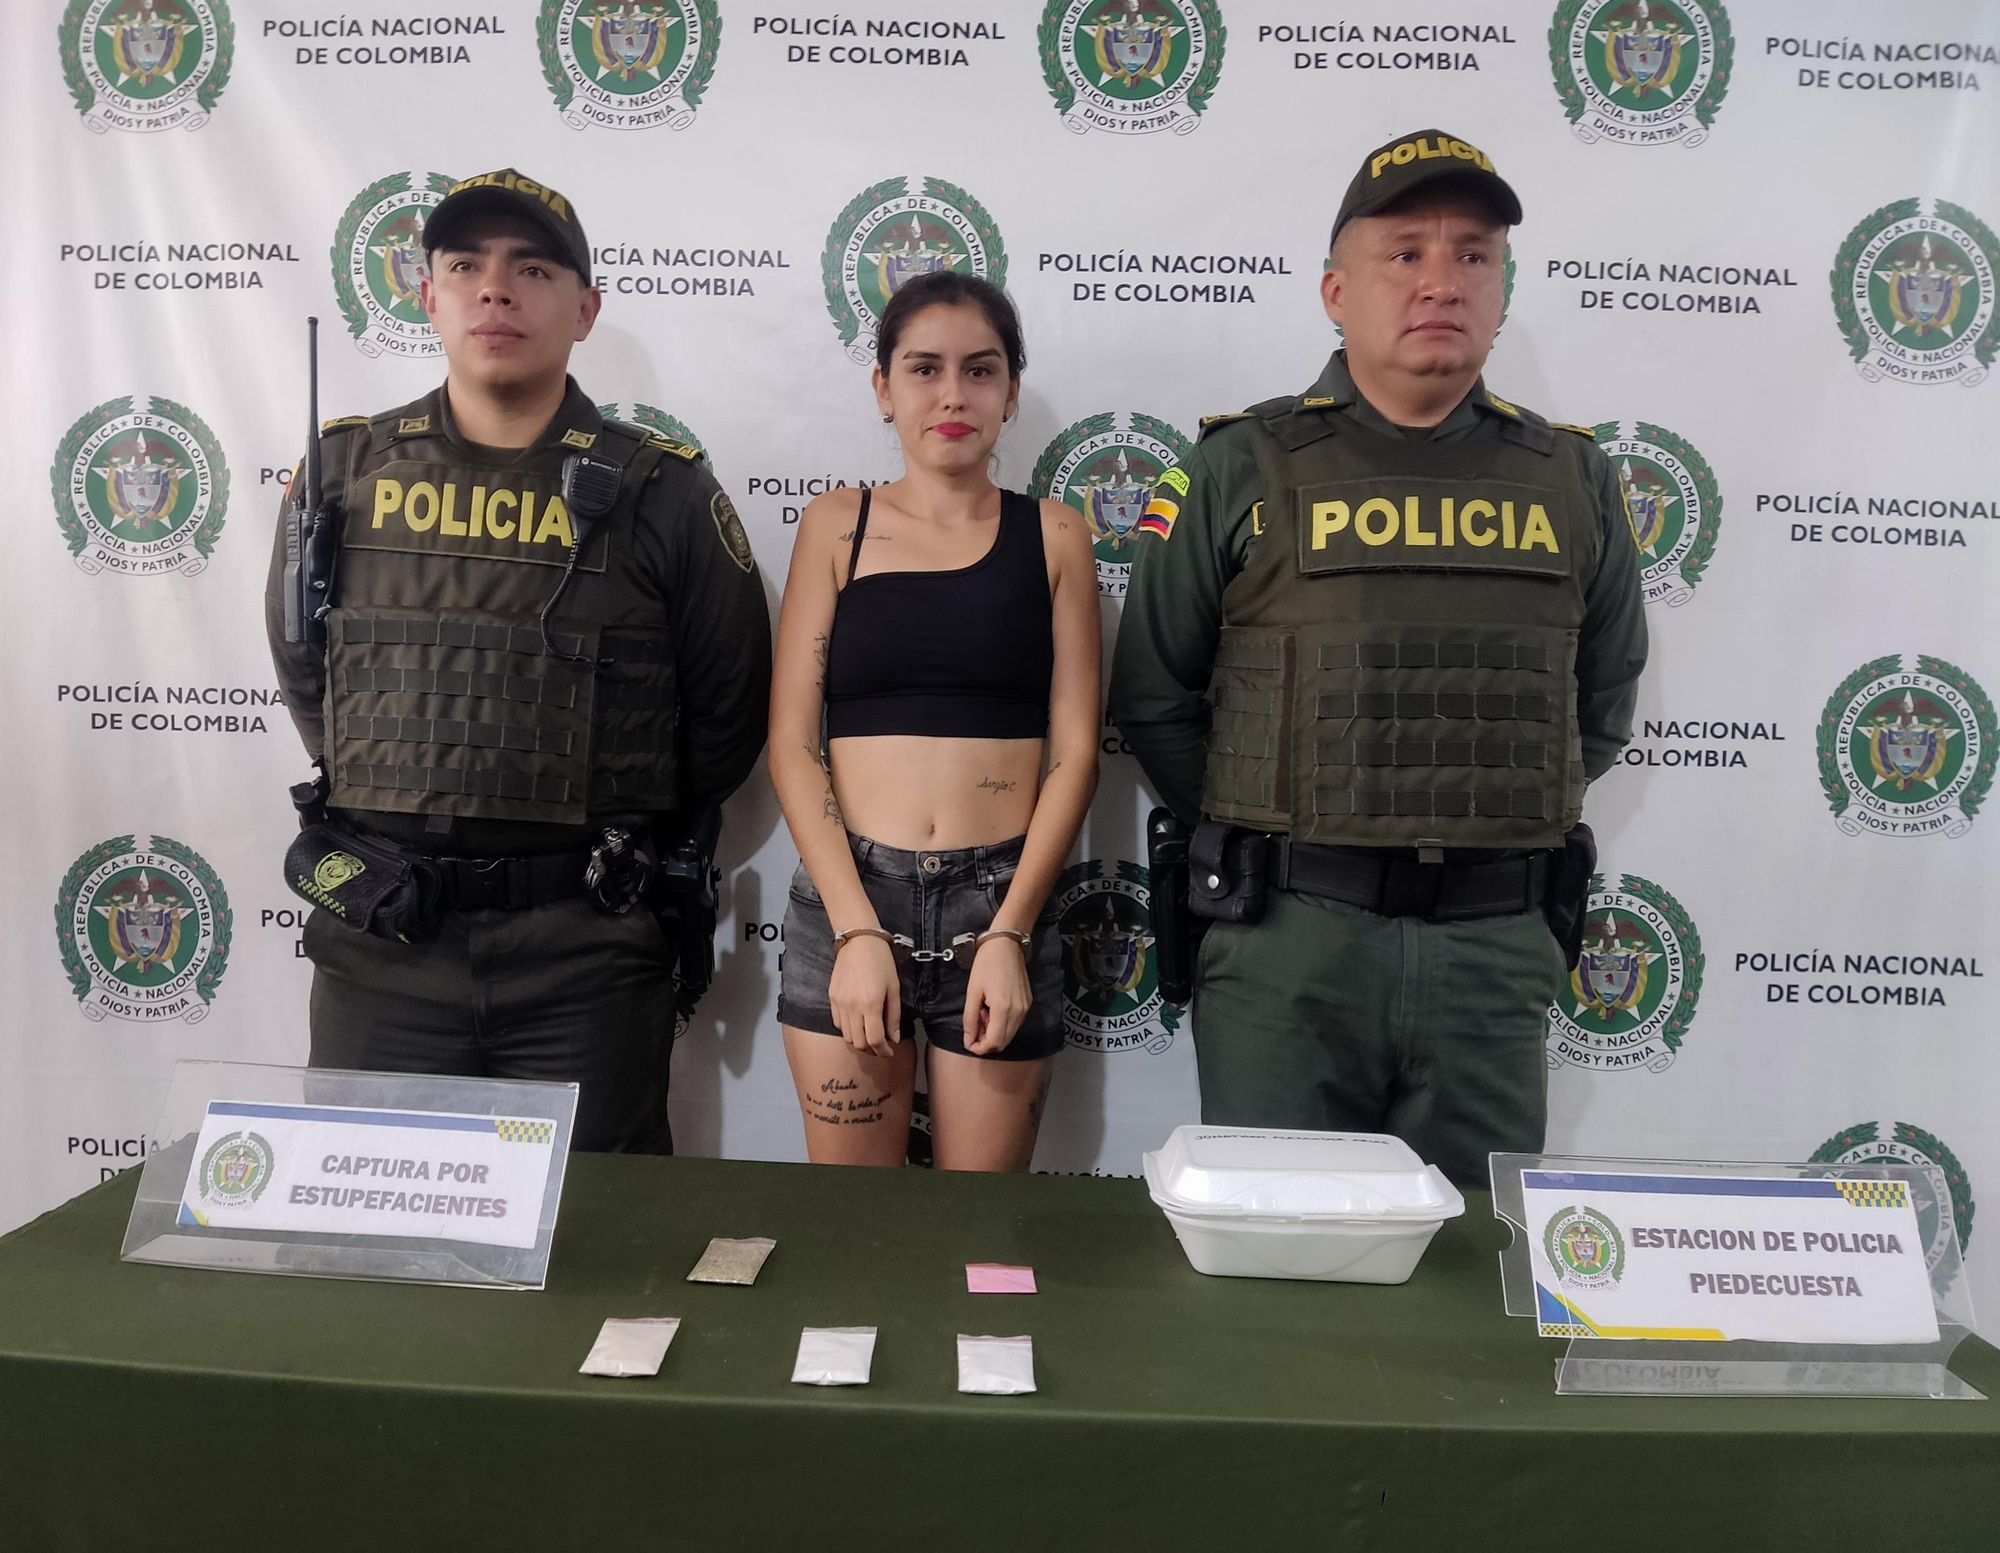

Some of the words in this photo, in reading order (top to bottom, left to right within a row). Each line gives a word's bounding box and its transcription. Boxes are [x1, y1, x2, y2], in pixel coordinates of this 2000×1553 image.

[197, 0, 214, 52] OMBIA
[262, 14, 364, 38] POLICÍA
[371, 14, 505, 37] NACIONAL
[682, 0, 698, 45] OMBIA
[753, 15, 857, 37] POLICÍA
[866, 20, 1006, 40] NACIONAL
[1062, 0, 1086, 52] REPUBL
[1259, 19, 1365, 43] POLICÍA
[1373, 25, 1516, 44] NACIONAL
[296, 47, 328, 65] DE
[336, 45, 471, 65] COLOMBIA
[788, 45, 820, 63] DE
[829, 46, 969, 67] COLOMBIA
[1294, 52, 1328, 69] DE
[1336, 52, 1480, 71] COLOMBIA
[1766, 37, 1866, 62] POLICÍA
[1874, 42, 2000, 64] NACIONA
[147, 68, 207, 111] NACIONAL
[629, 61, 691, 107] NACIONAL
[1132, 70, 1196, 112] NACIONAL
[1798, 68, 1830, 88] DE
[1838, 71, 1980, 91] COLOMBIA
[629, 105, 675, 125] PATRIA
[1641, 81, 1705, 123] NACIONAL
[147, 107, 190, 128] PATRIA
[1132, 110, 1180, 130] PATRIA
[1641, 122, 1688, 141] PATRIA
[411, 193, 429, 203] DE
[908, 199, 927, 209] DE
[942, 208, 985, 272] COLOMBI
[61, 240, 160, 263] POLICÍA
[168, 243, 300, 262] NACIONAL
[592, 242, 645, 266] ICÍA
[653, 248, 791, 268] NACIONAL
[1039, 249, 1143, 273] POLICÍA
[1152, 255, 1292, 275] NACIONAL
[1919, 219, 1937, 230] DE
[1952, 229, 1993, 305] COLOMBIA
[94, 272, 126, 290] DE
[134, 271, 264, 291] COLOMBIA
[1547, 257, 1651, 282] POLICÍA
[1659, 264, 1798, 286] NACIONAL
[596, 275, 608, 293] E
[616, 276, 755, 297] COLOMBIA
[1073, 283, 1106, 302] DE
[1114, 283, 1256, 304] COLOMBIA
[1580, 290, 1614, 309] DE
[1622, 291, 1761, 314] COLOMBIA
[422, 343, 443, 353] PAT
[1923, 322, 1985, 363] NACIONAL
[1922, 362, 1968, 380] PATRIA
[134, 416, 152, 426] DE
[168, 425, 209, 497] COLOMBIA
[1051, 440, 1099, 501] EPUBLICA
[1115, 434, 1134, 444] DE
[1619, 442, 1639, 452] DE
[1655, 452, 1698, 525] COLOMBIA
[371, 478, 575, 547] POLICIA
[1756, 490, 1860, 515] POLICÍA
[1868, 497, 2000, 519] NACIONAL
[142, 513, 203, 554] NACIONAL
[1311, 496, 1560, 554] POLICIA
[1791, 523, 1823, 543] DE
[1831, 525, 1967, 547] COLOMBIA
[143, 552, 188, 571] PATRIA
[1642, 541, 1691, 582] CIONAL
[1642, 582, 1672, 599] TRIA
[57, 680, 159, 704] POLICÍA
[166, 683, 285, 707] NACIONA
[91, 712, 123, 730] DE
[131, 713, 268, 733] COLOMBIA
[1901, 675, 1920, 685] DE
[1936, 684, 1977, 757] COLOMBIA
[1643, 720, 1786, 741] NACIONAL
[1904, 774, 1971, 815] NACIONAL
[1903, 814, 1952, 833] PATRIA
[136, 855, 154, 865] DE
[170, 864, 211, 938] COLOMBIA
[1102, 880, 1121, 891] DE
[1604, 895, 1623, 906] DE
[1638, 905, 1681, 984] COLOMBIA
[1735, 948, 1836, 973] POLICÍA
[1844, 954, 1984, 977] NACIONAL
[146, 956, 207, 1000] NACIONAL
[146, 997, 190, 1018] PATRIA
[1767, 983, 1800, 1003] DE
[1807, 984, 1946, 1006] COLOMBIA
[1108, 992, 1165, 1030] NACIONA
[1607, 1002, 1674, 1047] NACIONAL
[1107, 1028, 1153, 1048] PATRIA
[1606, 1046, 1655, 1066] PATRIA
[1877, 1144, 1897, 1155] DE
[321, 1154, 430, 1181] CAPTURA
[436, 1162, 489, 1184] POR
[288, 1183, 507, 1219] ESTUPEFACIENTES
[1631, 1227, 1756, 1251] ESTACION
[1762, 1231, 1798, 1252] DE
[1802, 1231, 1904, 1254] POLICIA
[1689, 1272, 1863, 1297] PIEDECUESTA
